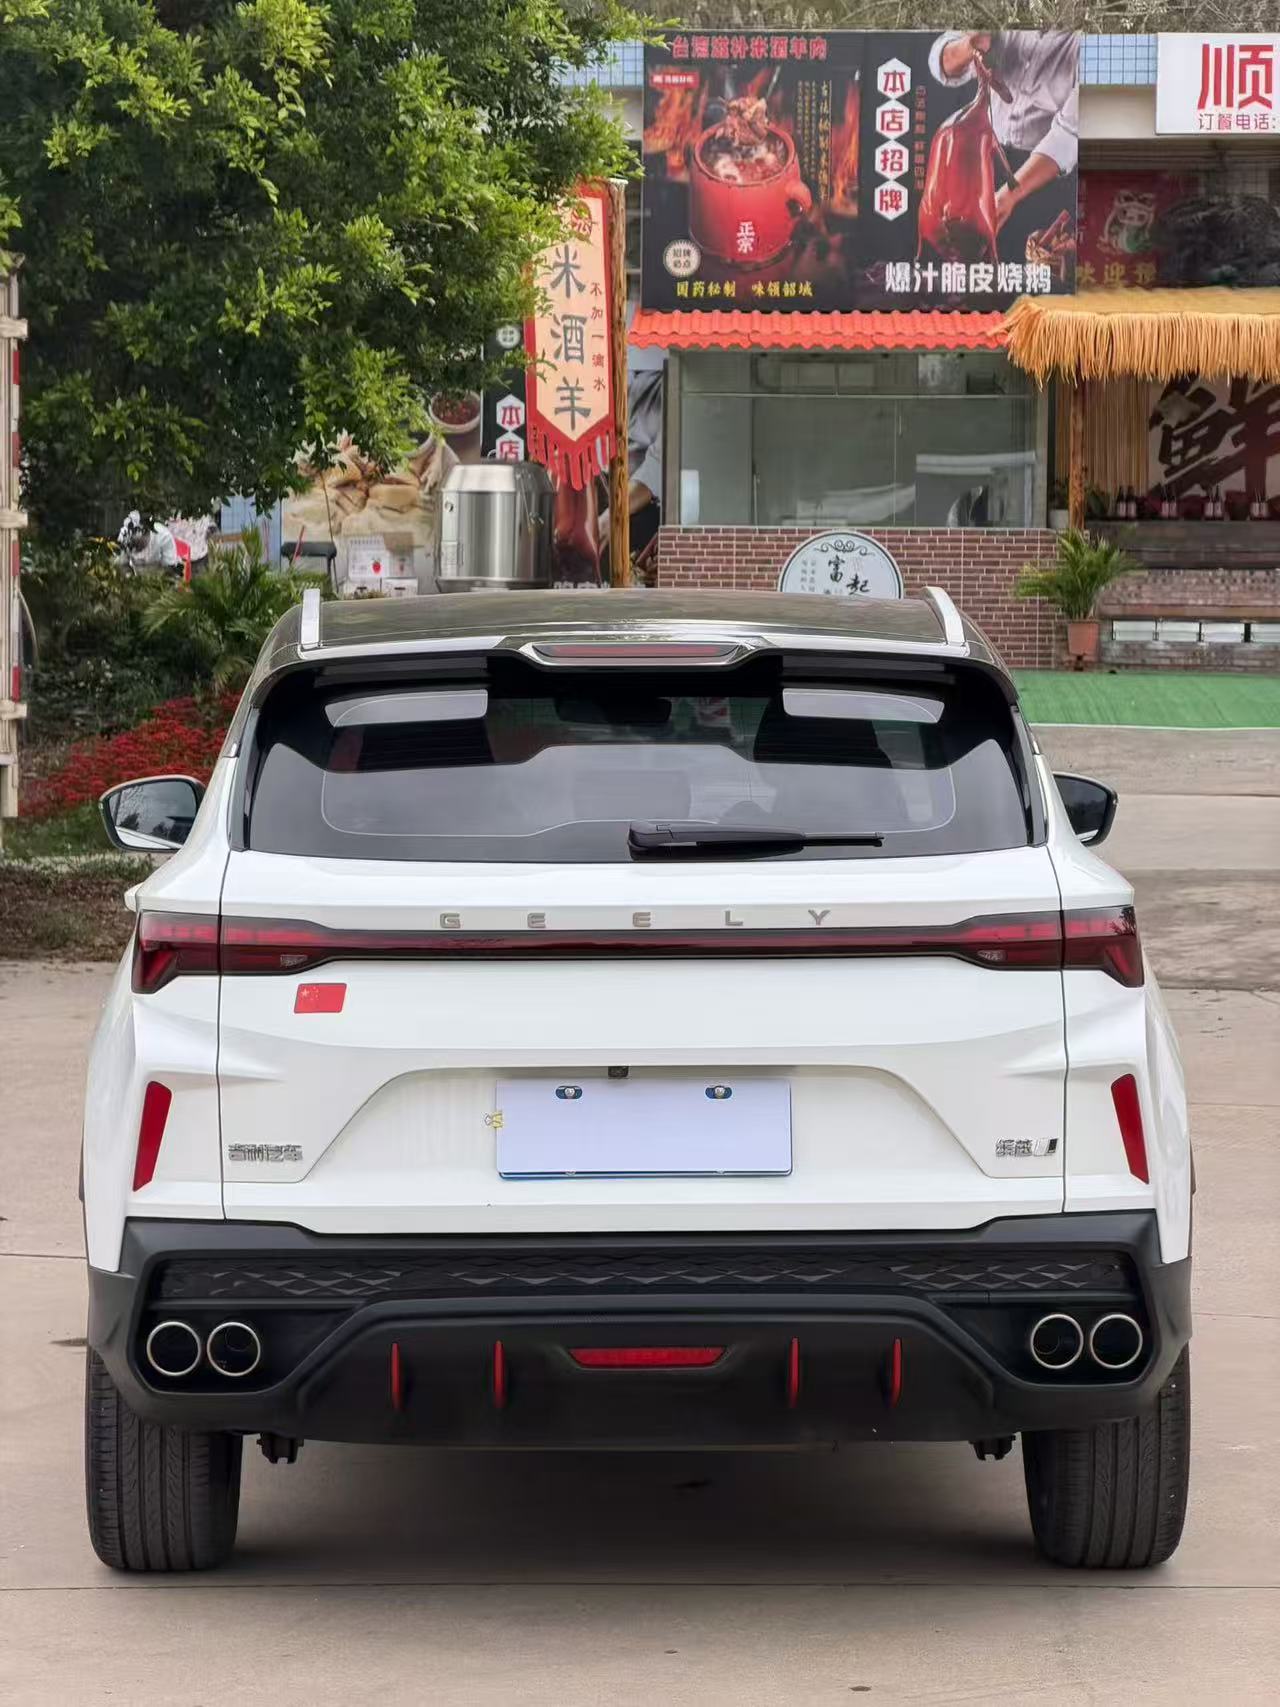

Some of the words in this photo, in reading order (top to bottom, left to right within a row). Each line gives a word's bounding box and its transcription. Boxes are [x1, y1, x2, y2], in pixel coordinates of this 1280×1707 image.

[879, 70, 906, 212] 本店招牌
[737, 221, 756, 254] 正宗
[885, 262, 1051, 293] 爆汁脆皮烧鹅
[549, 244, 592, 431] 米酒羊
[590, 282, 606, 392] 不加一滴水
[500, 404, 521, 460] 本店
[440, 909, 830, 929] GEELY
